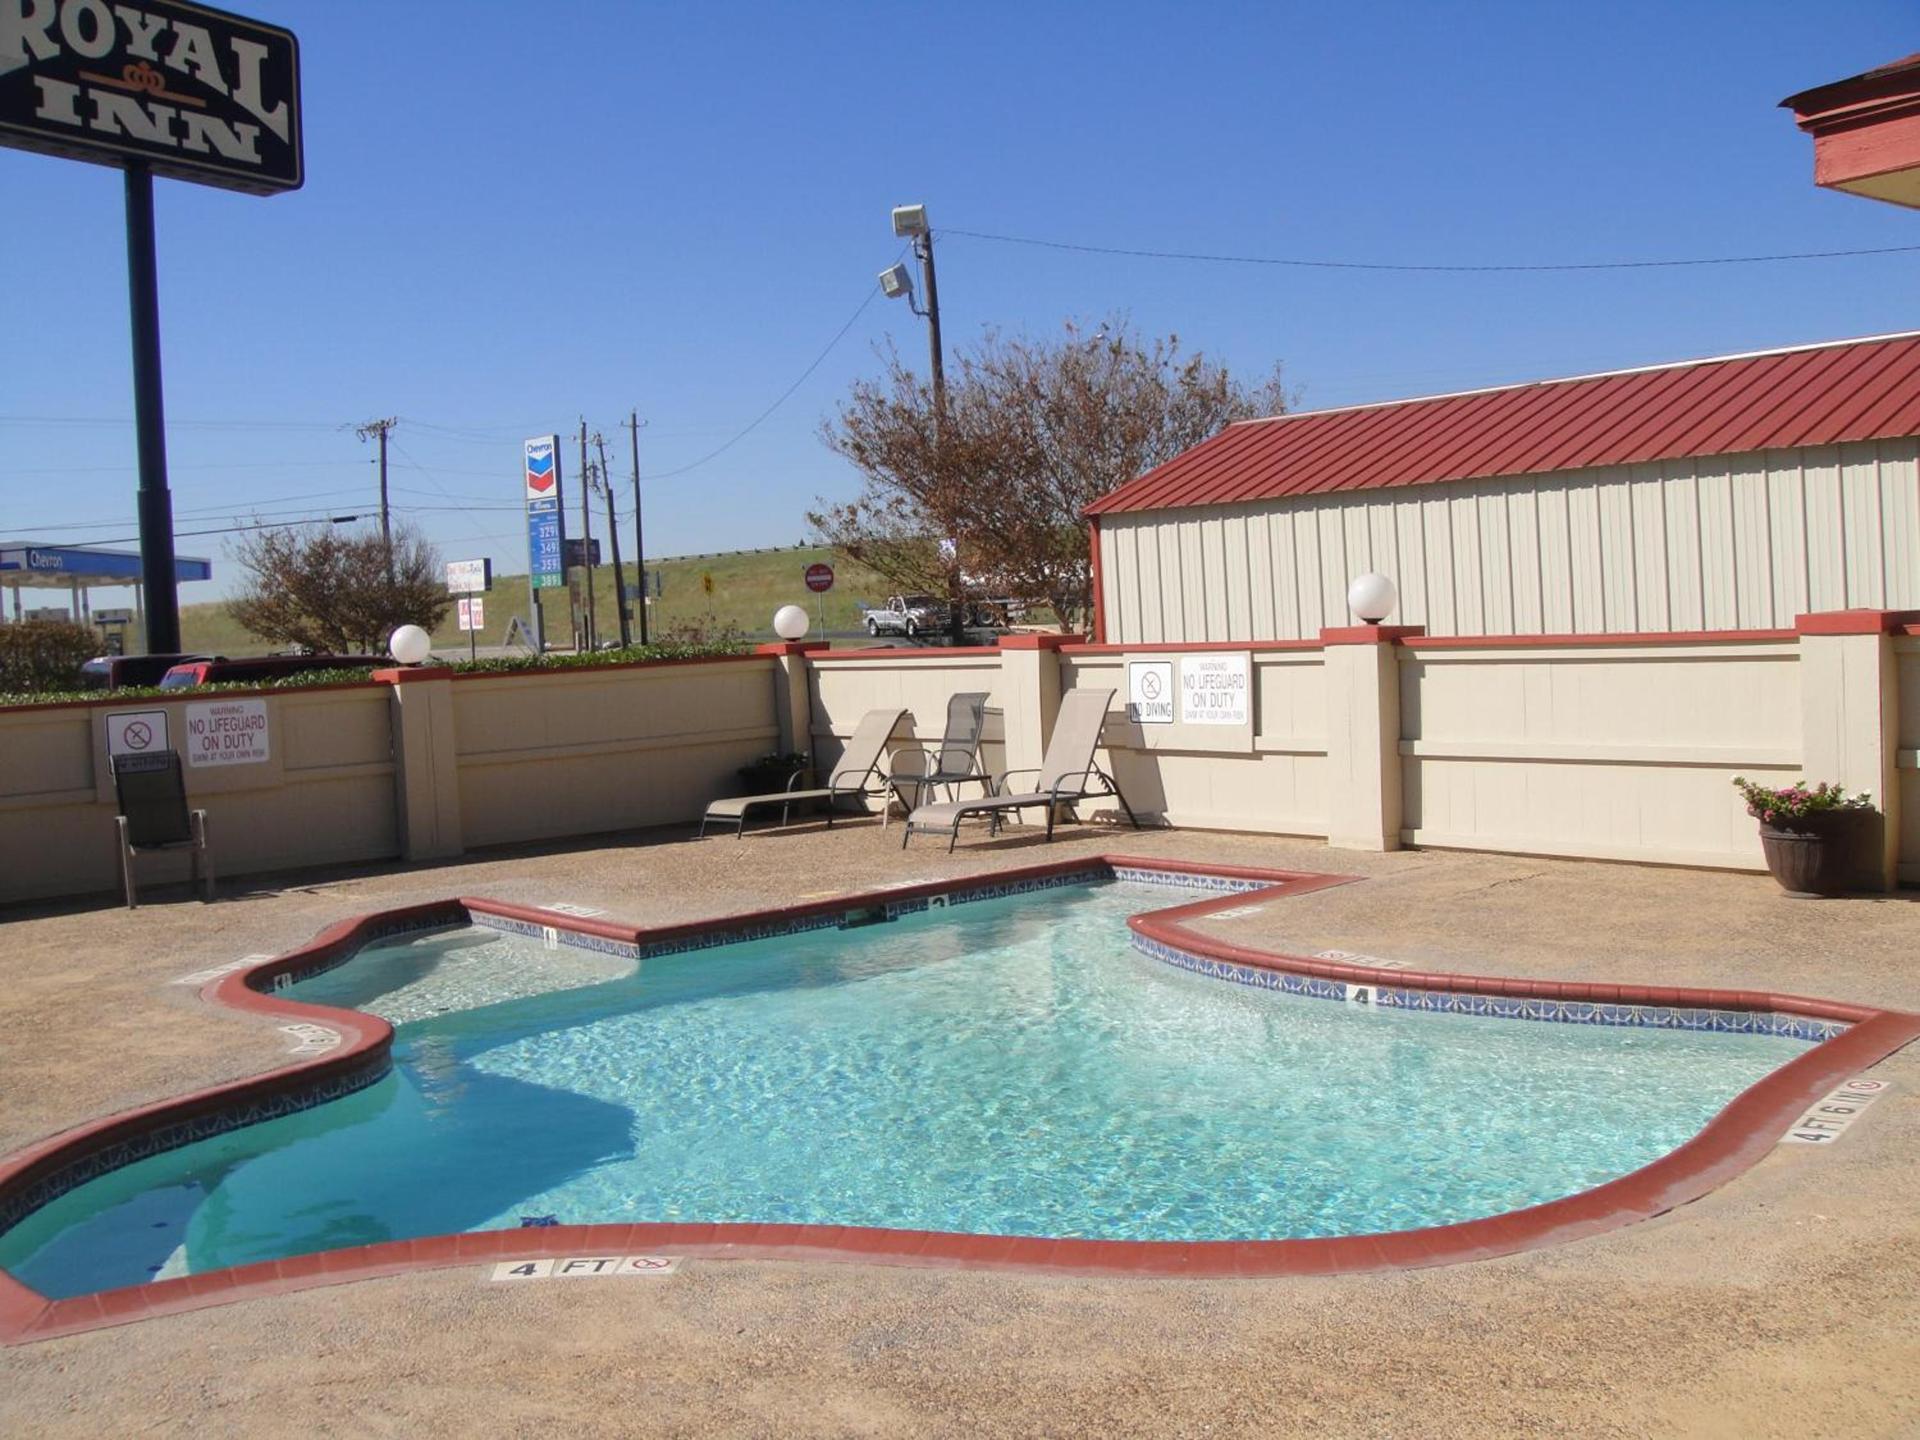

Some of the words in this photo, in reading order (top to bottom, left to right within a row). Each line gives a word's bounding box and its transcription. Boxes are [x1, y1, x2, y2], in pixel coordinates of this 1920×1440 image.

[0, 0, 290, 145] ROYAL
[33, 74, 262, 164] INN
[30, 550, 63, 568] Chevron
[1199, 662, 1228, 671] WARNING
[1183, 674, 1195, 690] NO
[1198, 673, 1245, 690] LIFEGUARD
[1192, 692, 1206, 708] ON
[1210, 692, 1236, 708] DUTY
[209, 705, 245, 716] WARNING
[1131, 703, 1143, 717] NO
[1146, 702, 1172, 717] DIVING
[189, 719, 206, 735] NO
[208, 715, 266, 734] LIFEGUARD
[201, 736, 220, 751] ON
[223, 733, 255, 749] DUTY
[1829, 1090, 1876, 1104] IN
[1820, 1105, 1856, 1115] 6
[1800, 1117, 1845, 1131] FT
[1793, 1133, 1832, 1141] 4
[509, 1262, 538, 1276] 4
[561, 1259, 616, 1274] FT
